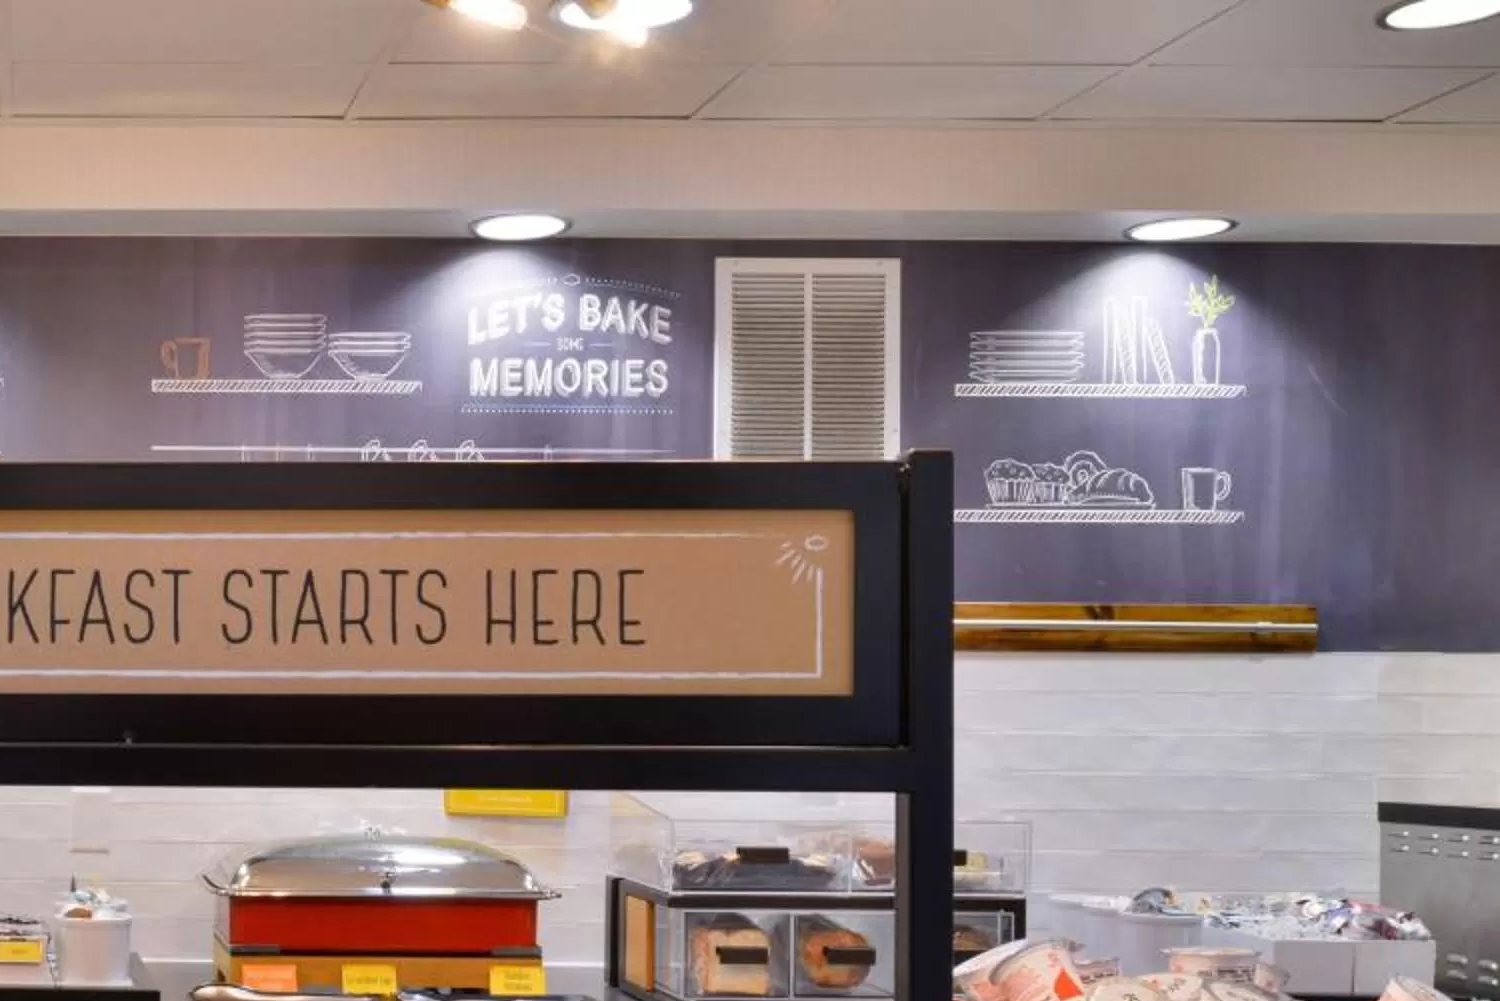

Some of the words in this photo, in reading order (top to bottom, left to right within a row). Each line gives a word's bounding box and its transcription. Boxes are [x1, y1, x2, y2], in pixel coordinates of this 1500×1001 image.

[467, 293, 565, 345] LET'S
[579, 293, 673, 345] BAKE
[469, 356, 669, 398] MEMORIES
[221, 568, 447, 645] STARTS
[485, 568, 646, 645] HERE
